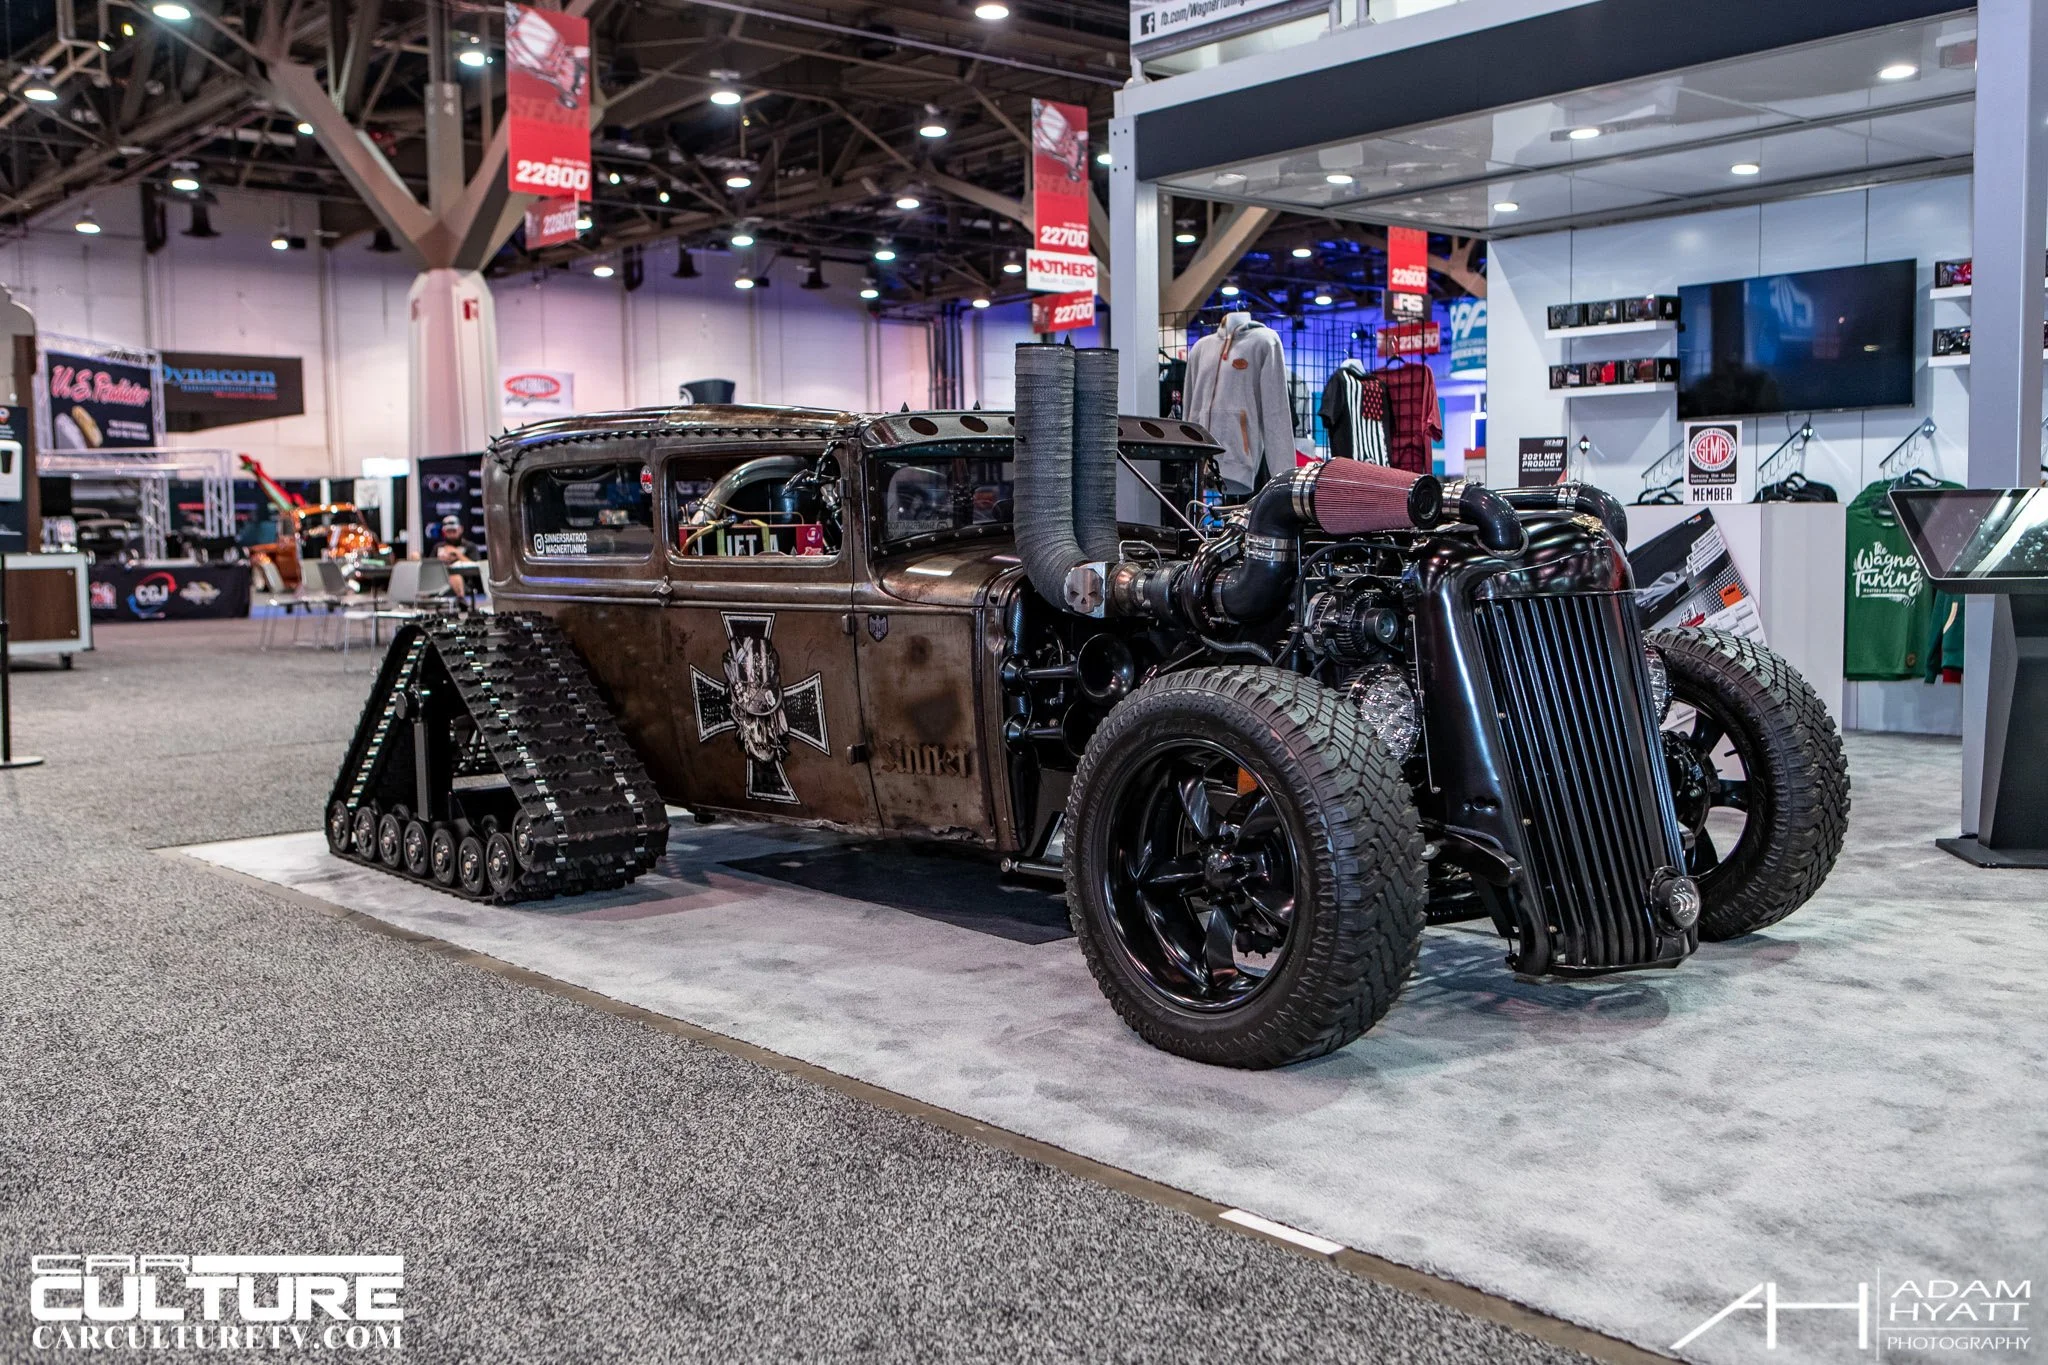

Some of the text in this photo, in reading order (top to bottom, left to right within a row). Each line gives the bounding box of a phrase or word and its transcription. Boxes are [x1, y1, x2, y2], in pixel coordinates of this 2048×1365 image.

[515, 160, 591, 191] 22800
[1040, 225, 1089, 248] 22700
[1029, 258, 1096, 279] MOTHERS
[1054, 303, 1093, 324] 22700
[1522, 452, 1563, 461] 2021 NEW
[1698, 435, 1729, 465] SEMA
[1522, 460, 1561, 468] PRODUCT
[1692, 487, 1733, 502] MEMBER
[543, 532, 587, 543] SINNERSRATROD
[545, 544, 587, 554] WAGNERTUNING
[1873, 541, 1888, 556] The
[1852, 568, 1923, 598] Tuning
[1681, 602, 1697, 625] #1
